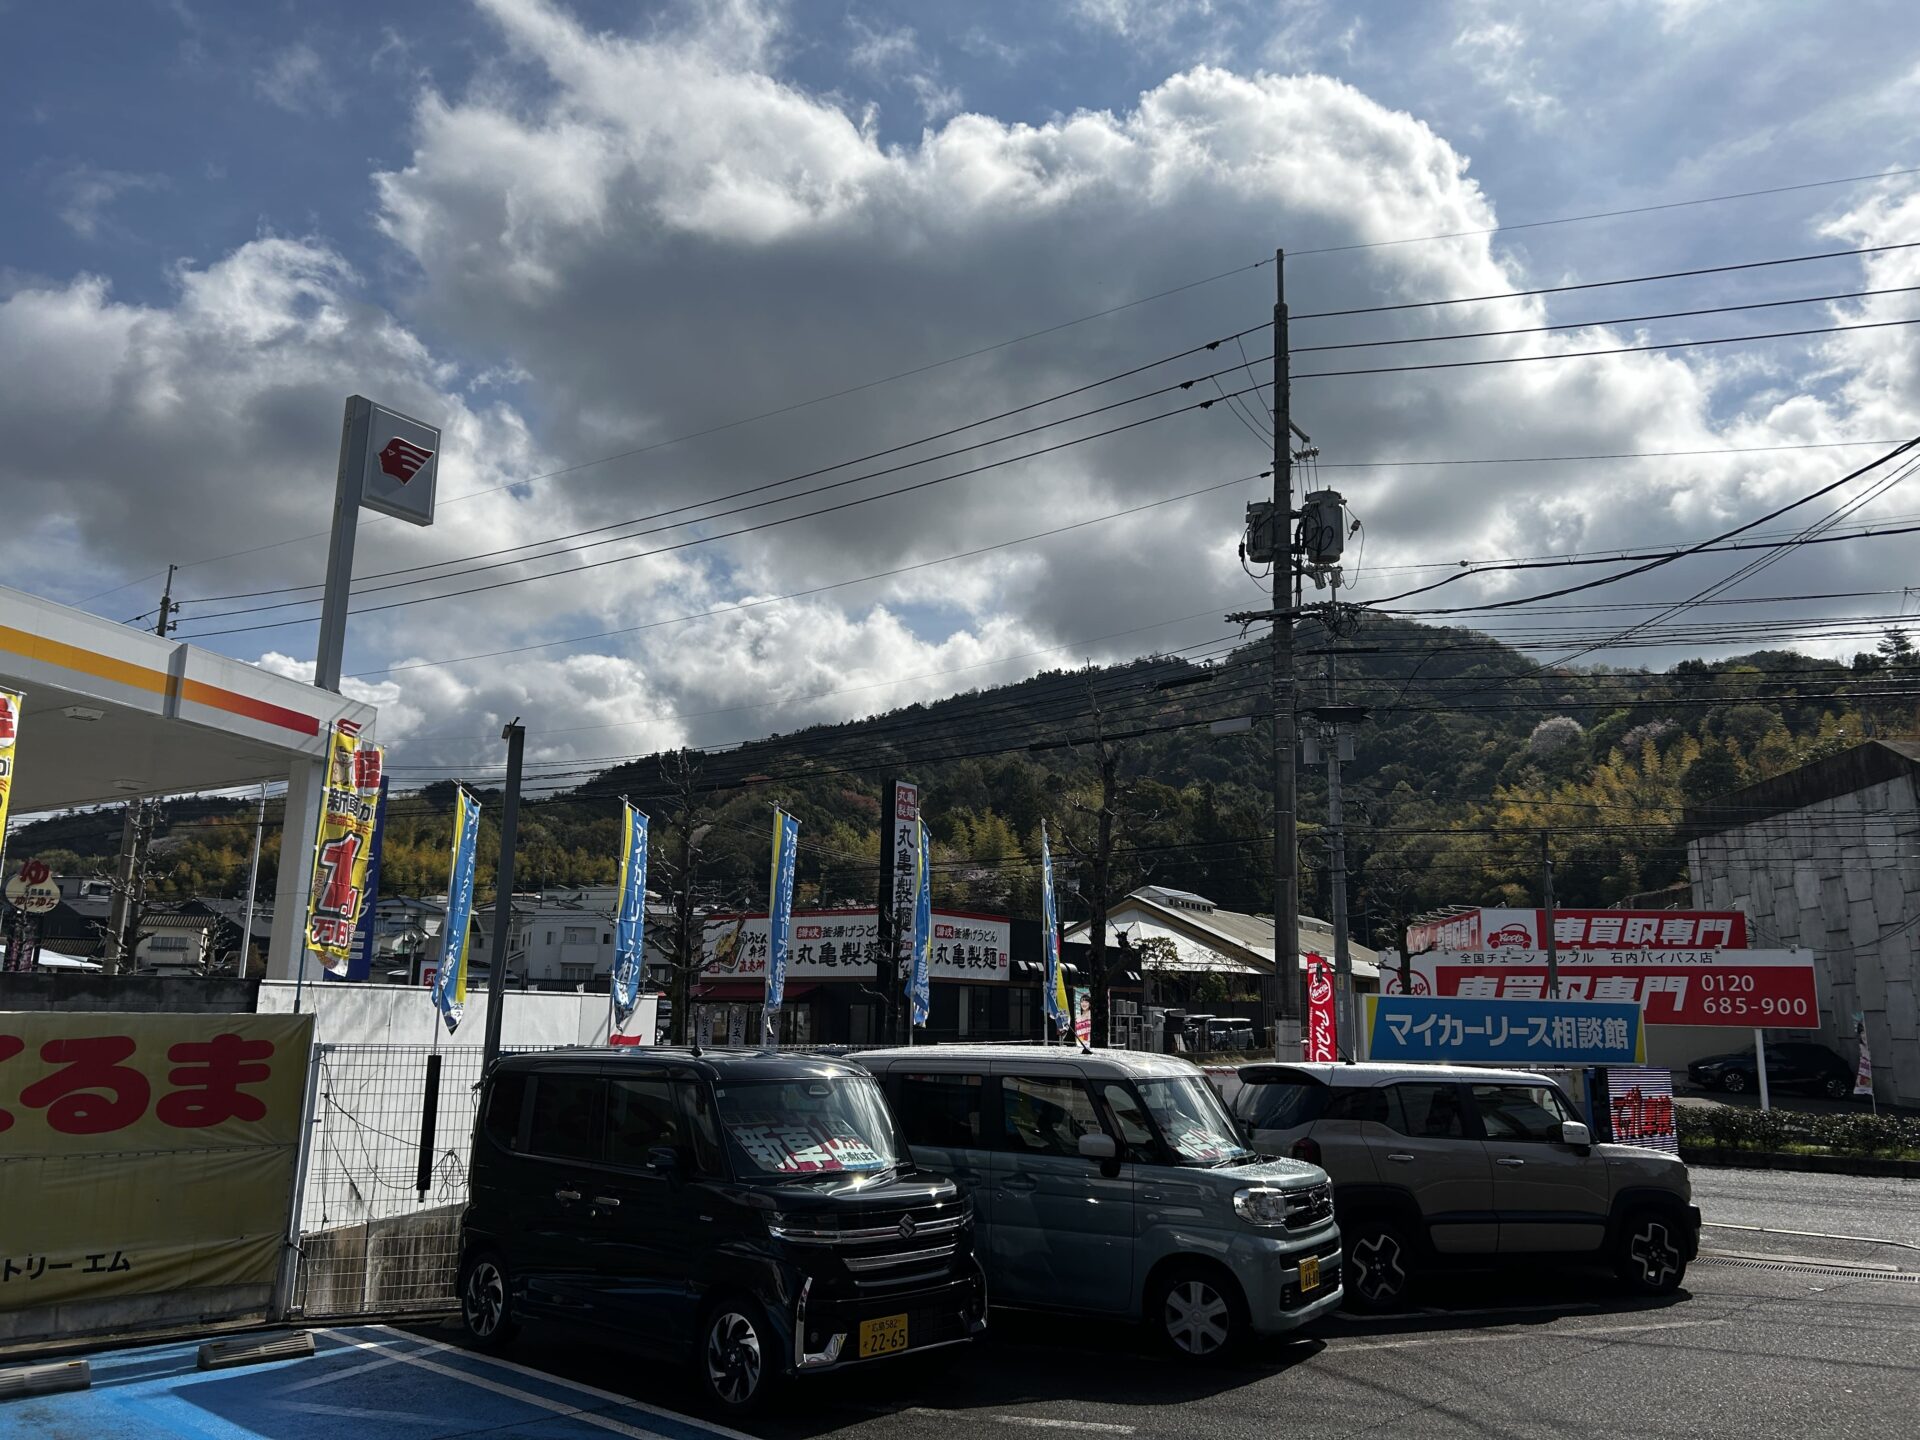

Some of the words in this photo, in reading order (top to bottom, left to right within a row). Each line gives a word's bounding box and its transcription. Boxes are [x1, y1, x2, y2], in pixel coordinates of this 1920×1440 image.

[748, 931, 768, 944] うどん
[822, 924, 878, 939] 釜揚げうど
[954, 927, 998, 943] 釜揚げうどん
[1554, 917, 1732, 946] 車買取専門
[749, 944, 766, 957] 弁当
[935, 942, 998, 970] 丸亀製麺
[1460, 952, 1535, 965] 全国チェーン
[1701, 974, 1755, 993] 0120
[1703, 997, 1807, 1016] 685-900
[1385, 1013, 1629, 1050] マイカーリース相談館
[871, 1329, 905, 1352] 22-65
